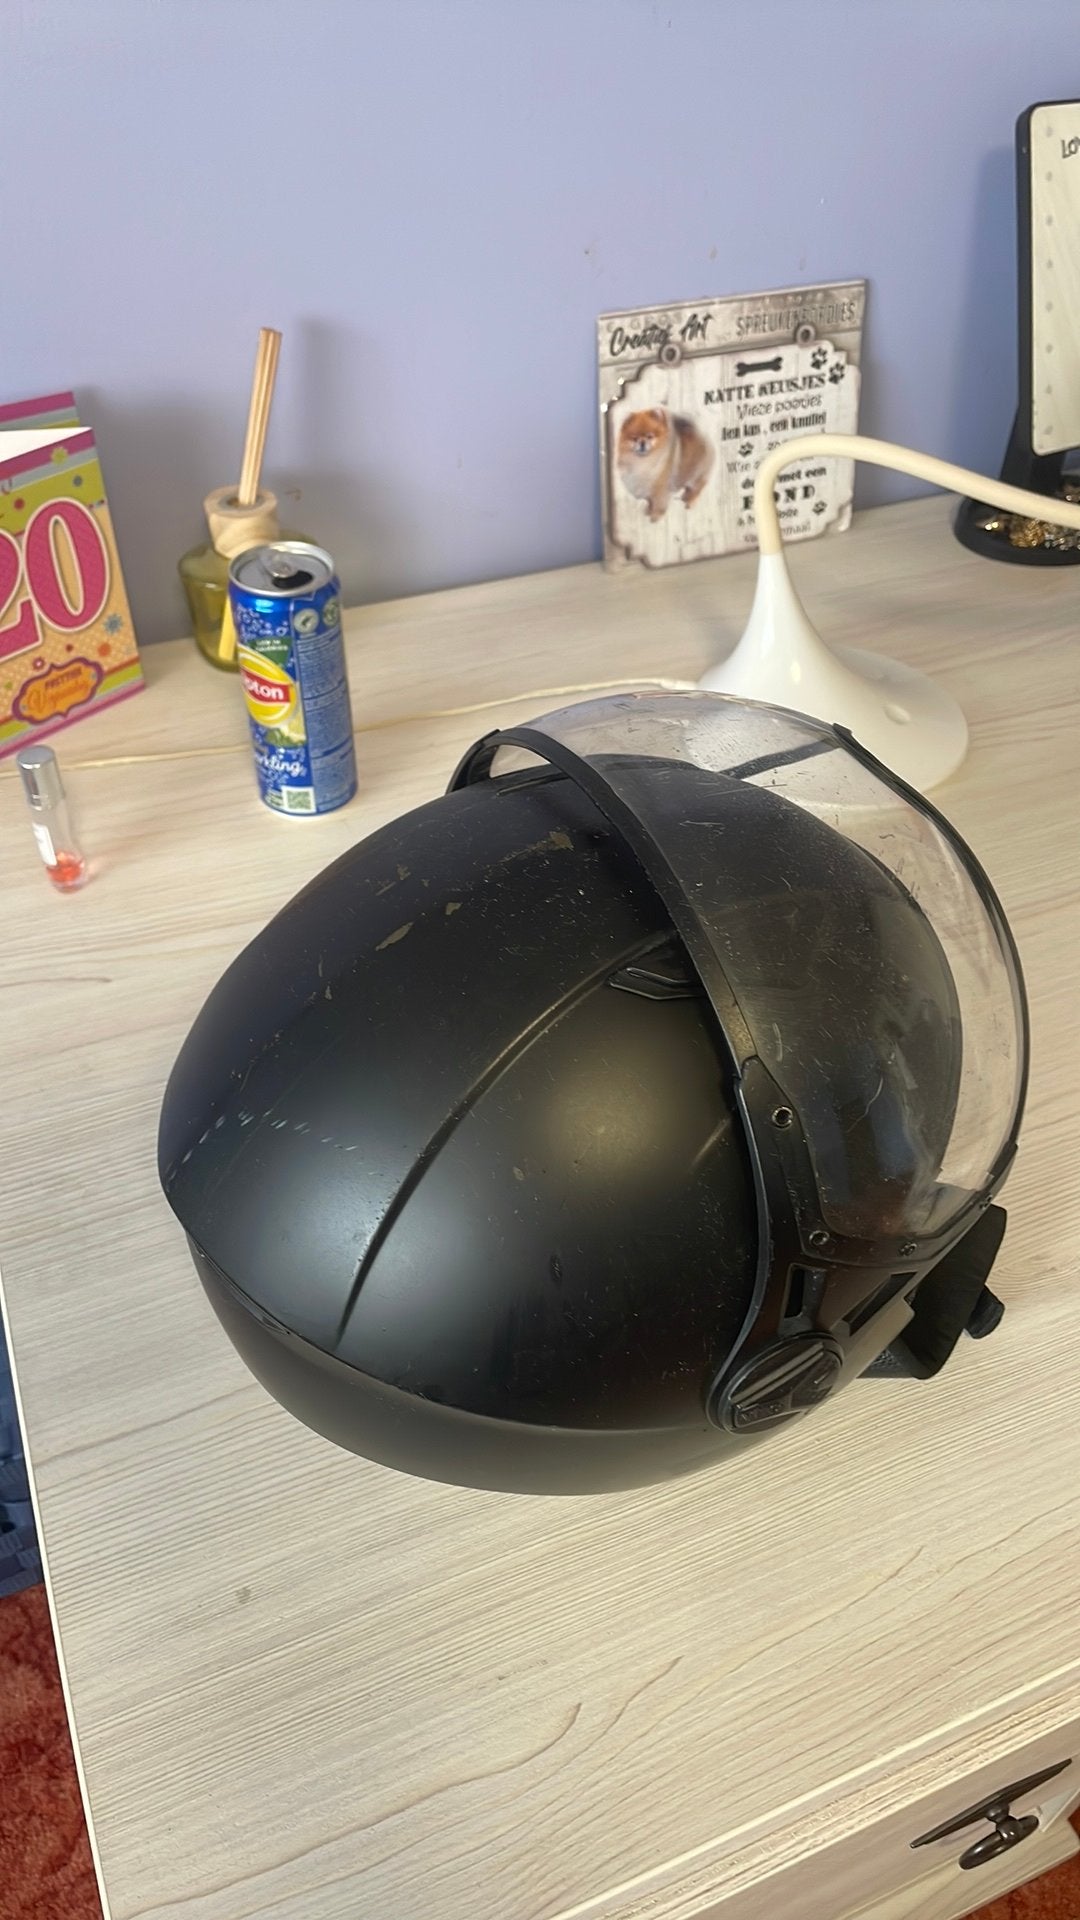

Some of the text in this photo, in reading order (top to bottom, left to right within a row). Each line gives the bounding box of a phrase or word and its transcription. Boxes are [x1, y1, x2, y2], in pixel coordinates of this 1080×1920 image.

[704, 373, 826, 405] NATTE NEUSJES
[244, 678, 285, 701] pton
